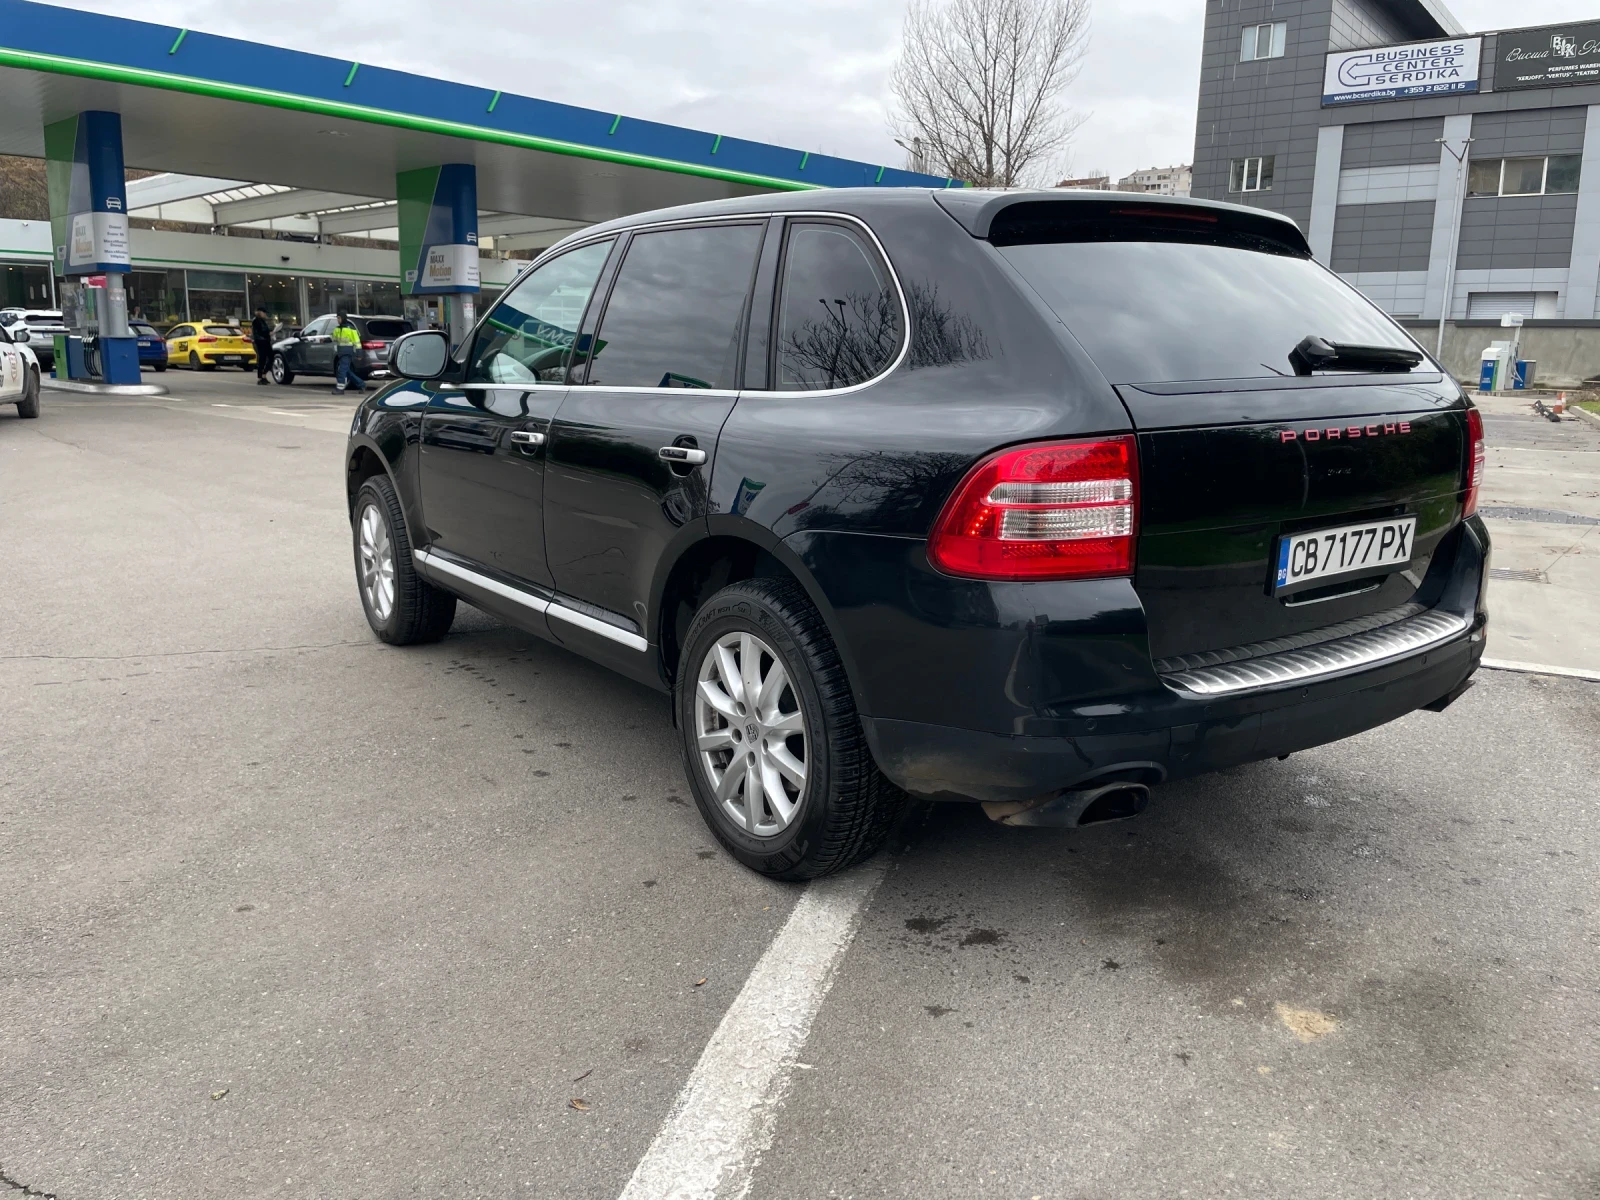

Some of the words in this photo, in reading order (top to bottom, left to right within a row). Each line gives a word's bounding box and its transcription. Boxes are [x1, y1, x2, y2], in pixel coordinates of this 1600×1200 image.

[1375, 44, 1465, 62] BUSINESS
[1382, 56, 1455, 73] CENTER
[1375, 68, 1460, 85] SERDIKA
[1333, 89, 1396, 101] www.bcserdika.bg
[1403, 86, 1424, 94] +359
[430, 254, 445, 264] MAXX
[429, 264, 452, 277] Motion
[1280, 422, 1412, 444] PORSCHE
[1277, 568, 1287, 581] BG
